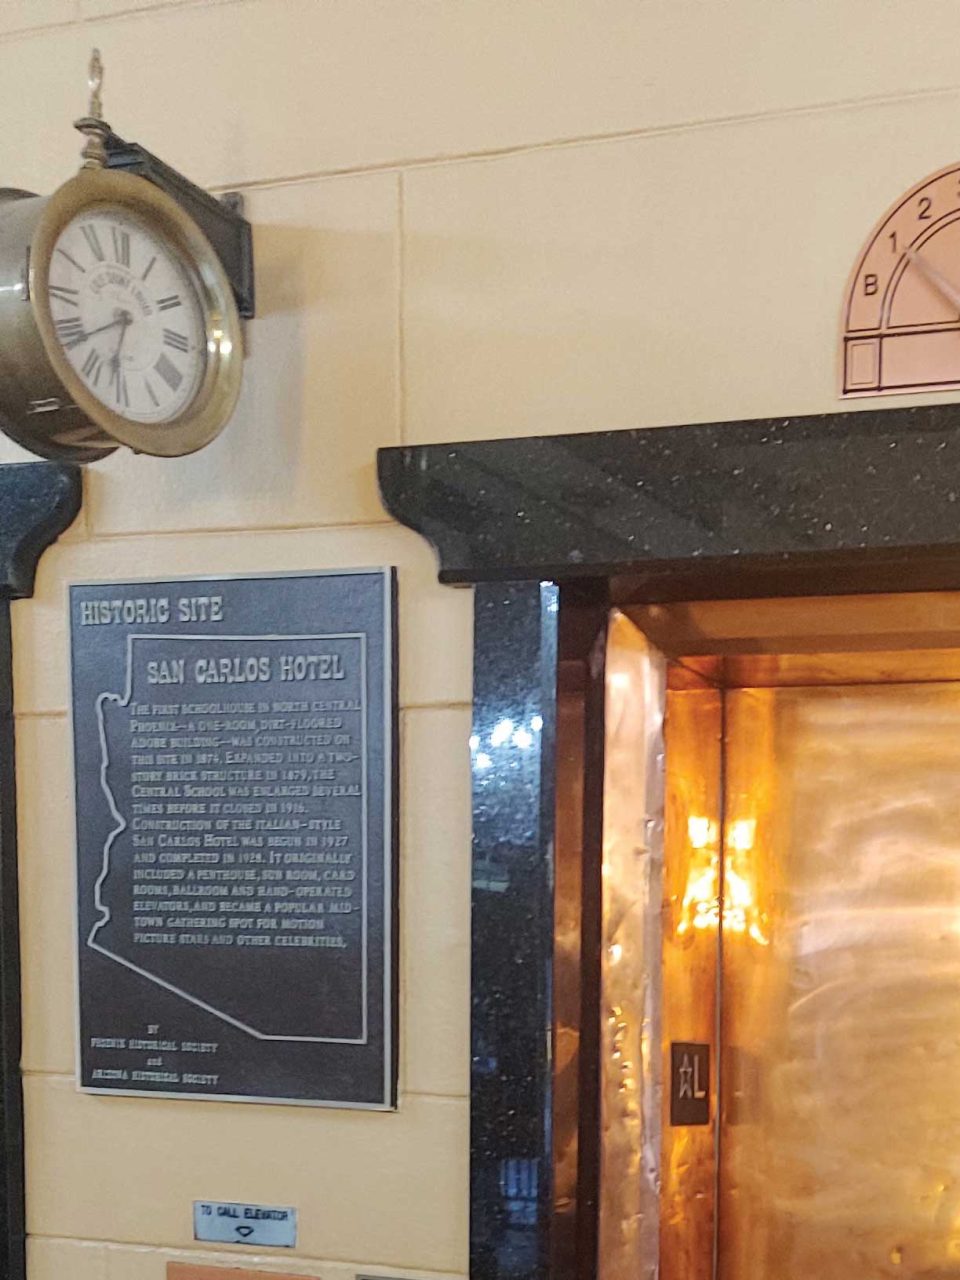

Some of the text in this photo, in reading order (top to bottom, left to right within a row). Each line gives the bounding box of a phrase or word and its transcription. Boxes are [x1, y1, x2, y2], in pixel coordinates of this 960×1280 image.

[863, 274, 878, 296] B
[889, 231, 898, 252] 1
[917, 197, 933, 220] 2
[79, 595, 224, 626] HISTORIC SITE
[146, 654, 345, 685] SAN CARLOS HOTEL
[201, 1203, 289, 1222] TO CALL ELEVATOR
